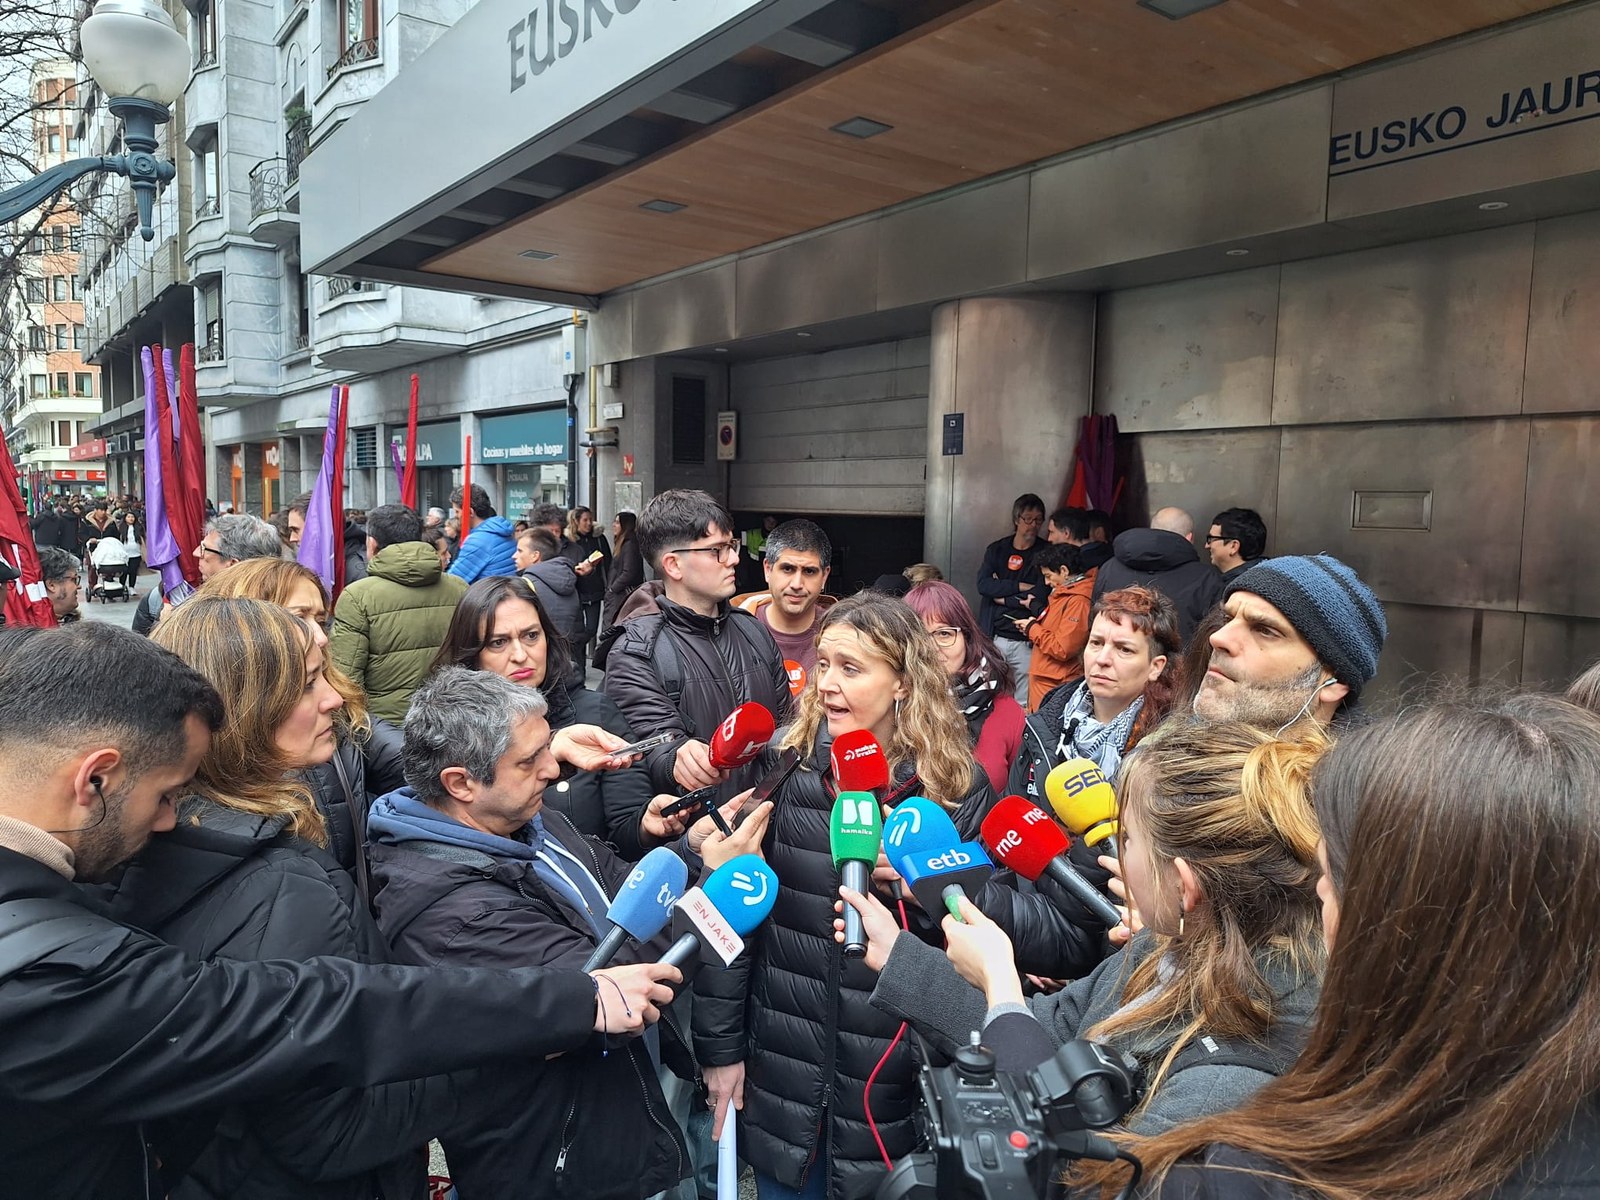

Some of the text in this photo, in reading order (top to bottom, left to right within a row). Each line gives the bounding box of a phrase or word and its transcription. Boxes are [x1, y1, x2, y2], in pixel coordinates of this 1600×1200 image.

[507, 0, 641, 93] EUSK
[1329, 70, 1600, 166] EUSKO JAUR
[483, 446, 504, 458] Cocinas
[509, 444, 534, 457] muebles
[534, 443, 543, 455] de
[543, 442, 563, 457] hogar
[841, 827, 873, 836] hamaika
[927, 848, 971, 870] etb
[693, 901, 736, 953] EN JAKE
